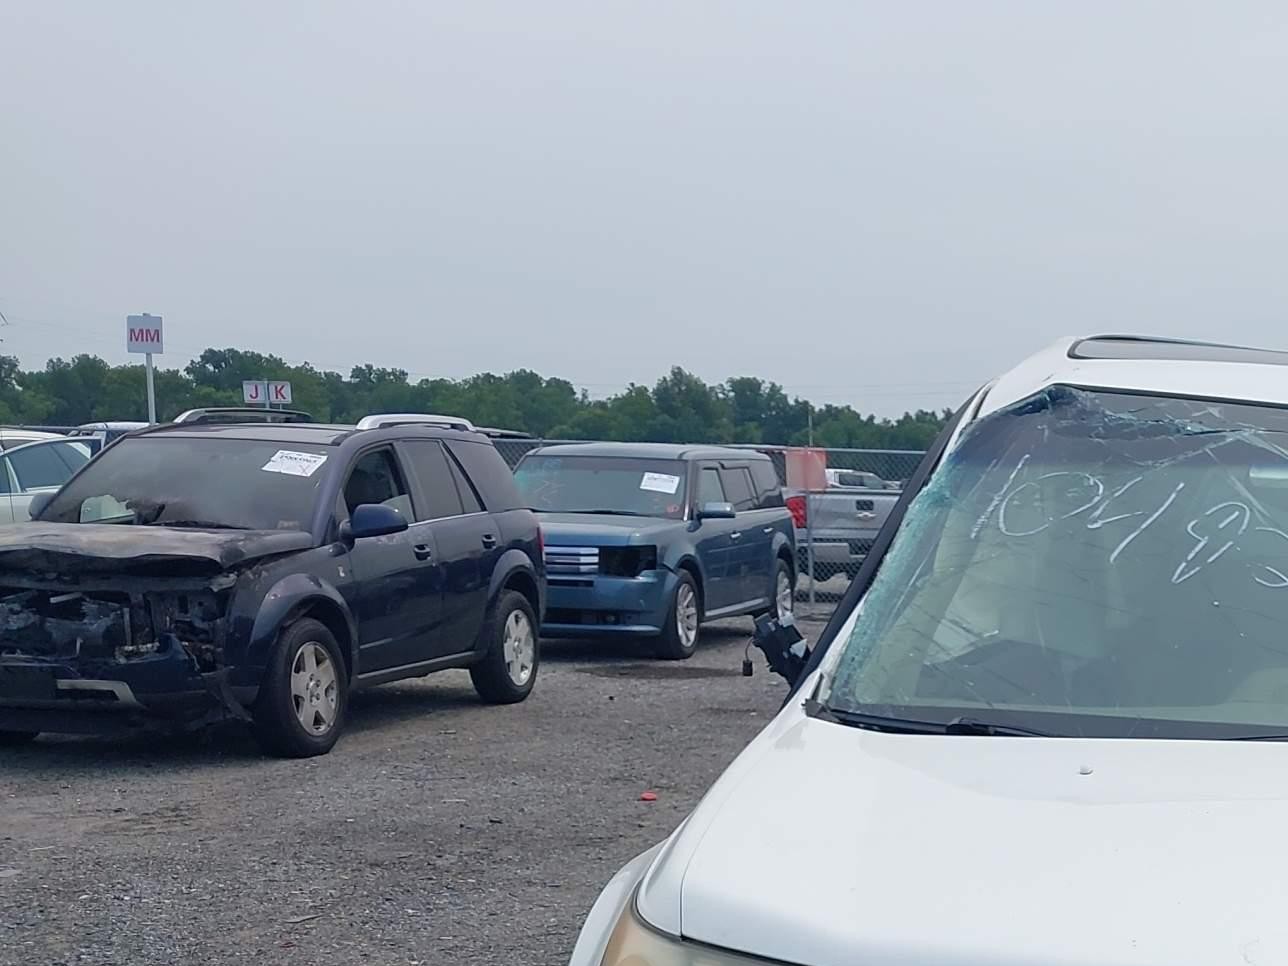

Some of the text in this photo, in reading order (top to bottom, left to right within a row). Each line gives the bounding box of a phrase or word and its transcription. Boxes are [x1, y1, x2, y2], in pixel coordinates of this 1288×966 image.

[128, 328, 161, 343] MM
[249, 385, 287, 400] J K
